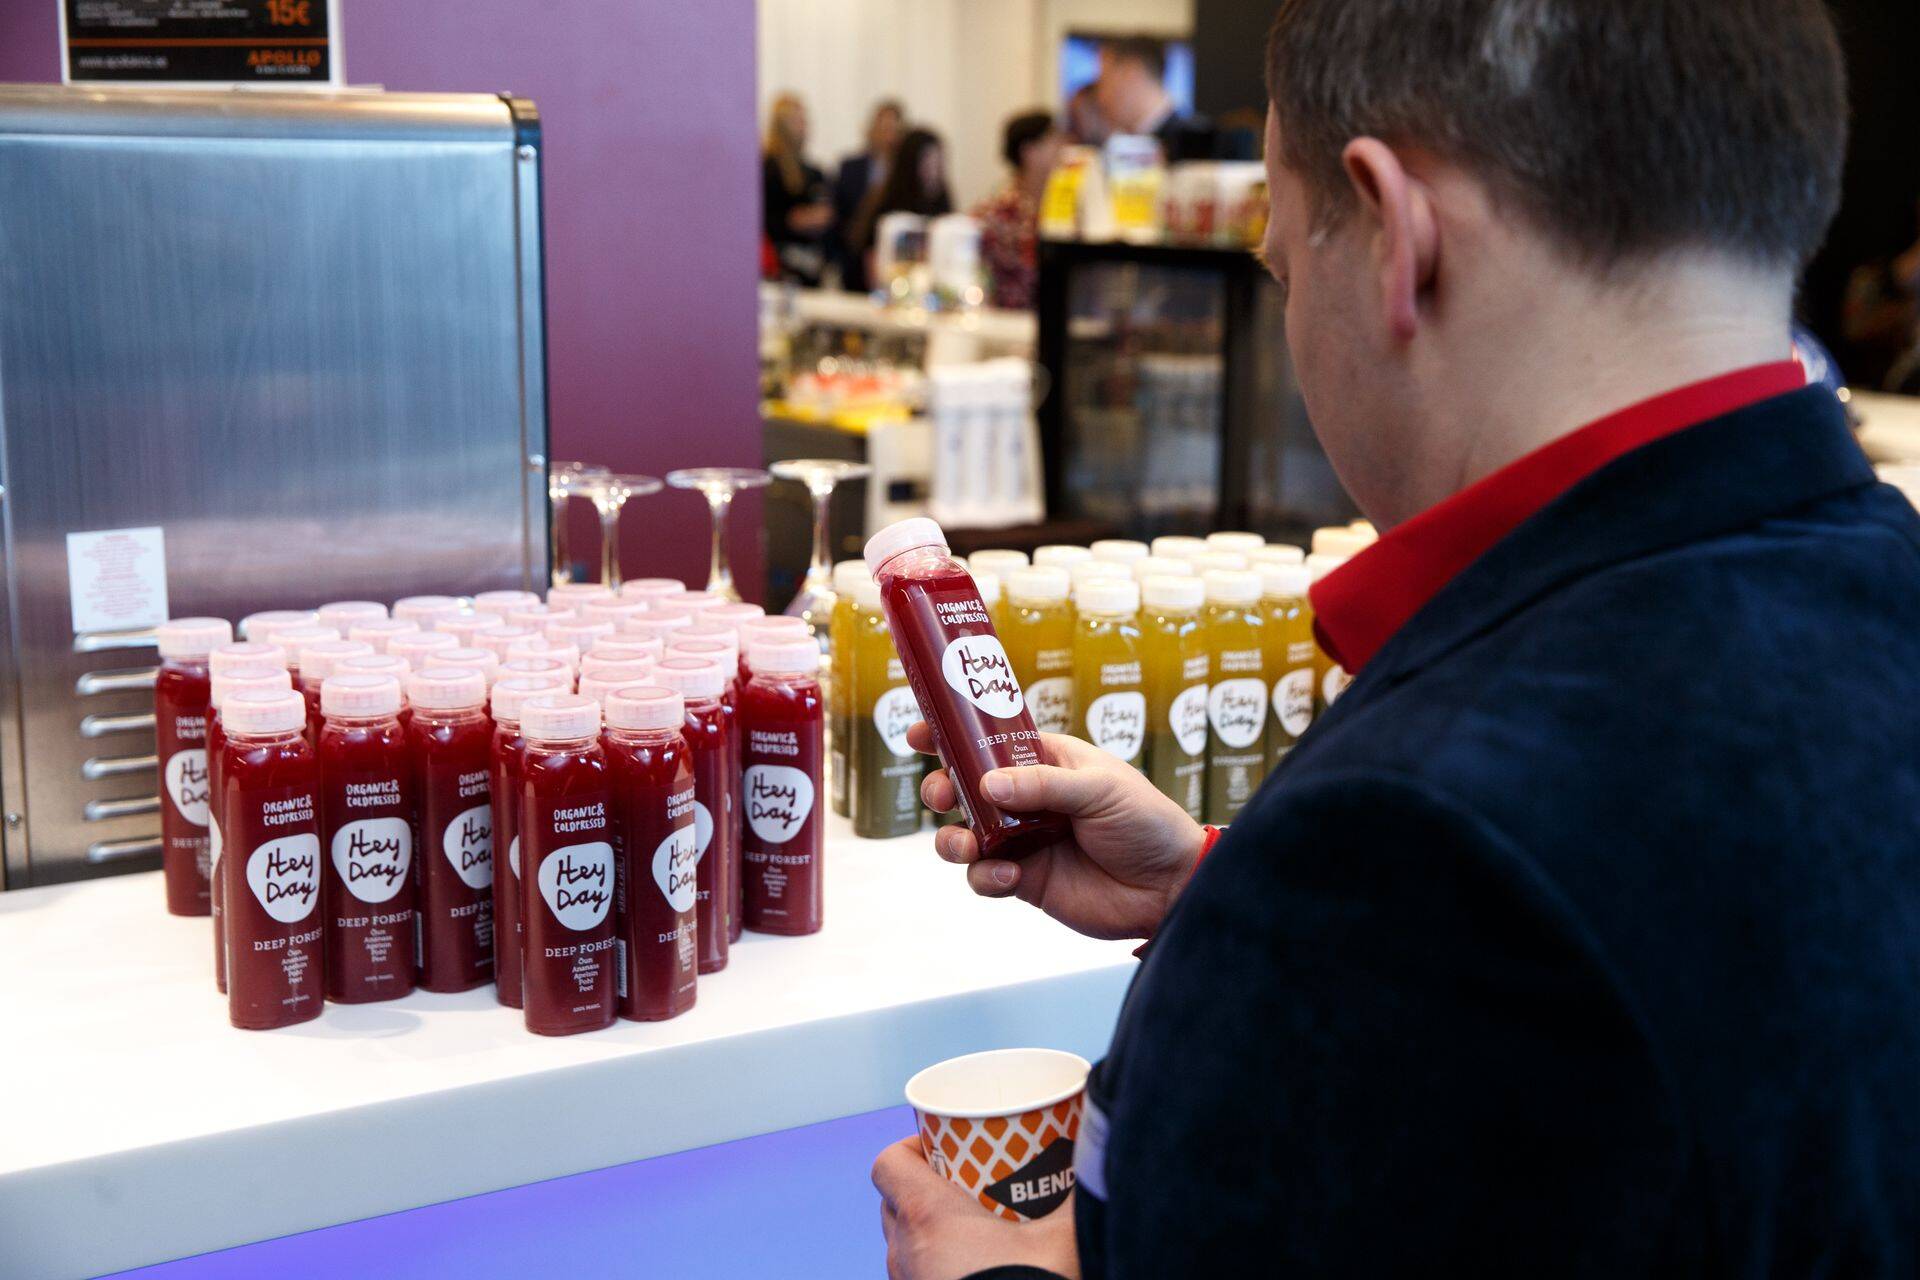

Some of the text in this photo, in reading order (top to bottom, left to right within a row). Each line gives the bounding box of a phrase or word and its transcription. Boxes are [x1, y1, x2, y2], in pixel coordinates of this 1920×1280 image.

[266, 0, 311, 26] 15€
[247, 49, 321, 67] APOLLO
[936, 599, 984, 615] ORGANIC&
[958, 645, 1010, 678] Hey
[968, 678, 1019, 703] Day
[977, 730, 1041, 749] DEEP FORE
[1011, 751, 1037, 760] Ananass
[181, 758, 209, 783] He
[181, 788, 210, 805] Da
[346, 779, 399, 795] ORGANIC&
[752, 773, 796, 807] Hey
[263, 794, 313, 814] ORGANIC&
[346, 794, 401, 807] COLDPRESSED
[264, 808, 314, 827] COLDPRESSED
[553, 802, 605, 820] ORGANIC&
[752, 802, 800, 829] Day
[554, 817, 606, 833] COLDPRESSED
[349, 829, 399, 861] Hey
[266, 847, 313, 879] Hey
[769, 854, 811, 865] FOREST
[350, 862, 404, 886] Day
[557, 855, 605, 887] Hey
[267, 882, 316, 905] Day
[557, 889, 609, 913] Day
[337, 909, 412, 928] DEEP FOREST
[451, 905, 478, 918] DEEP
[254, 938, 286, 951] DEEP
[545, 936, 616, 957] DEEP FOREST
[572, 963, 599, 973] Ananass
[1010, 1169, 1076, 1203] BLEND
